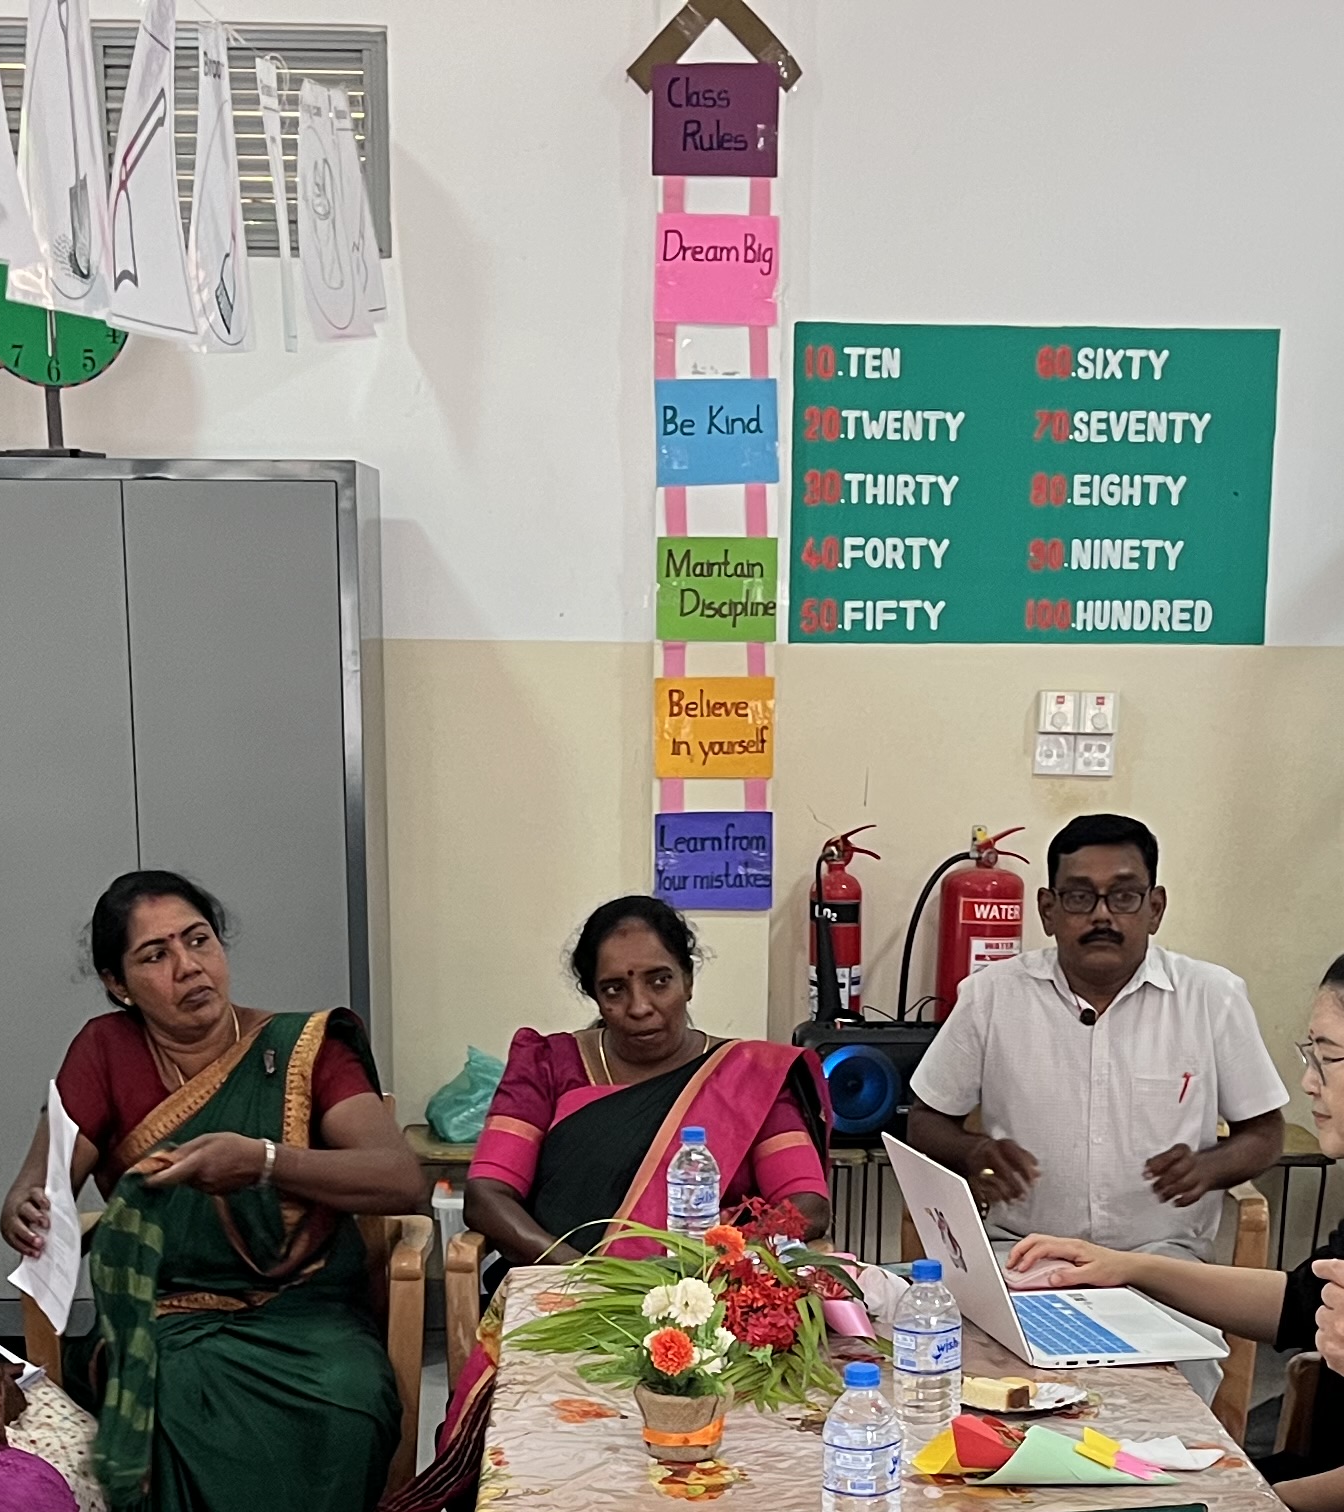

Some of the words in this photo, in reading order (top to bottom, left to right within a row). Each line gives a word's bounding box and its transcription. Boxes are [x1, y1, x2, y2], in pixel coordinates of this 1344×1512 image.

[667, 76, 731, 109] Class
[682, 119, 748, 152] Rules
[662, 229, 740, 263] Dream
[744, 233, 774, 276] Big
[662, 405, 696, 436] Be
[707, 403, 764, 436] Kind
[665, 548, 765, 579] Maintain
[680, 587, 778, 628] Discipline
[668, 688, 749, 718] Believe
[698, 726, 769, 766] yourself
[659, 825, 722, 854] Learn
[724, 823, 766, 852] from
[692, 861, 773, 891] mistakes
[974, 903, 1021, 920] WATER
